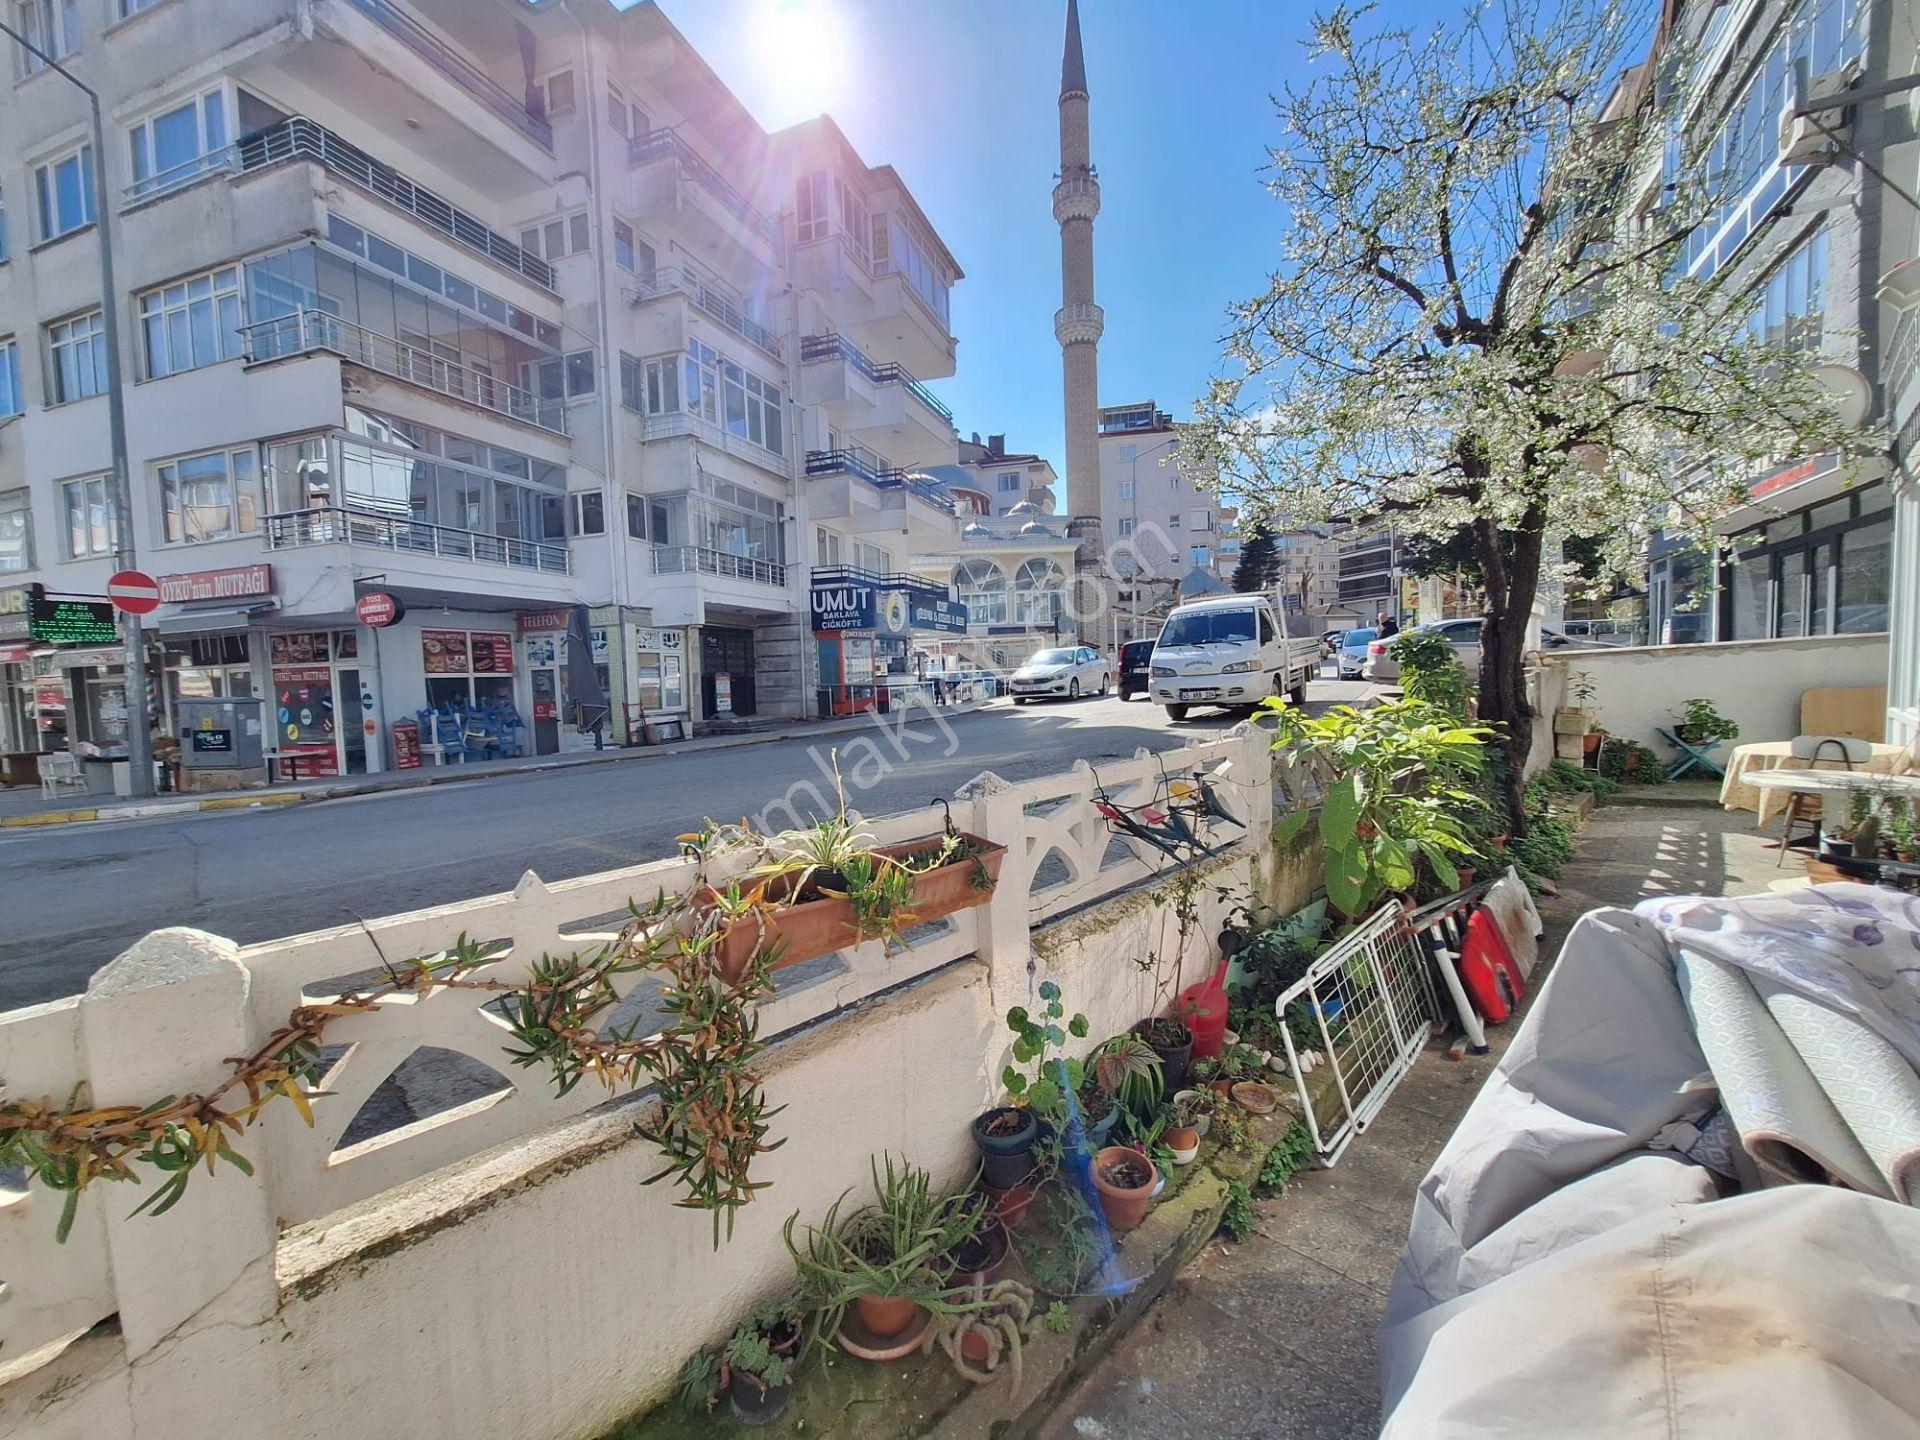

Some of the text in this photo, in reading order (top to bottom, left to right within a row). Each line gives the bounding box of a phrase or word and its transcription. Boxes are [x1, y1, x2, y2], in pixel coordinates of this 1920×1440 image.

[214, 566, 265, 597] MUTFAĞI
[812, 587, 871, 613] UMUT
[523, 613, 560, 628] TELEFON
